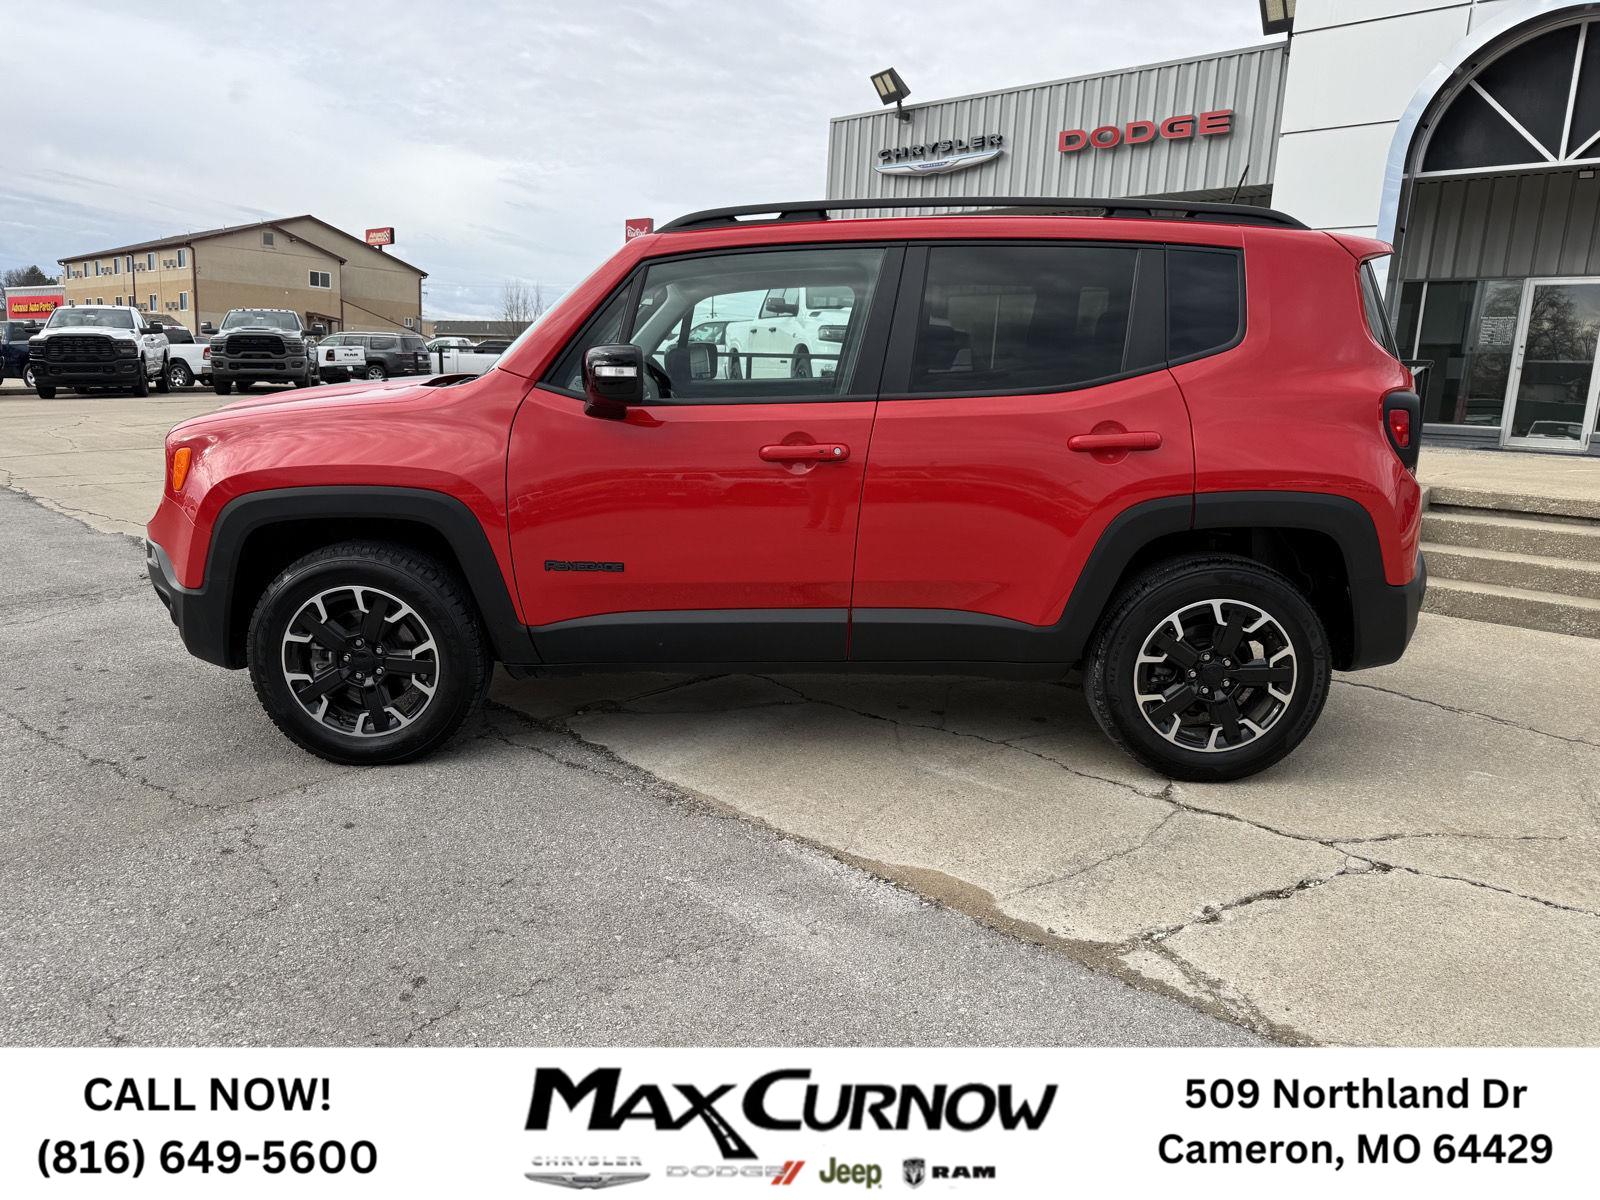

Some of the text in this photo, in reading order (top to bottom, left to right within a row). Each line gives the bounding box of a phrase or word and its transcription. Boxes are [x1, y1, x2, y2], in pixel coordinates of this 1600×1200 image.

[1058, 109, 1235, 153] DODGE
[878, 133, 1003, 162] CHRYSLER
[544, 560, 625, 573] RENEGADE
